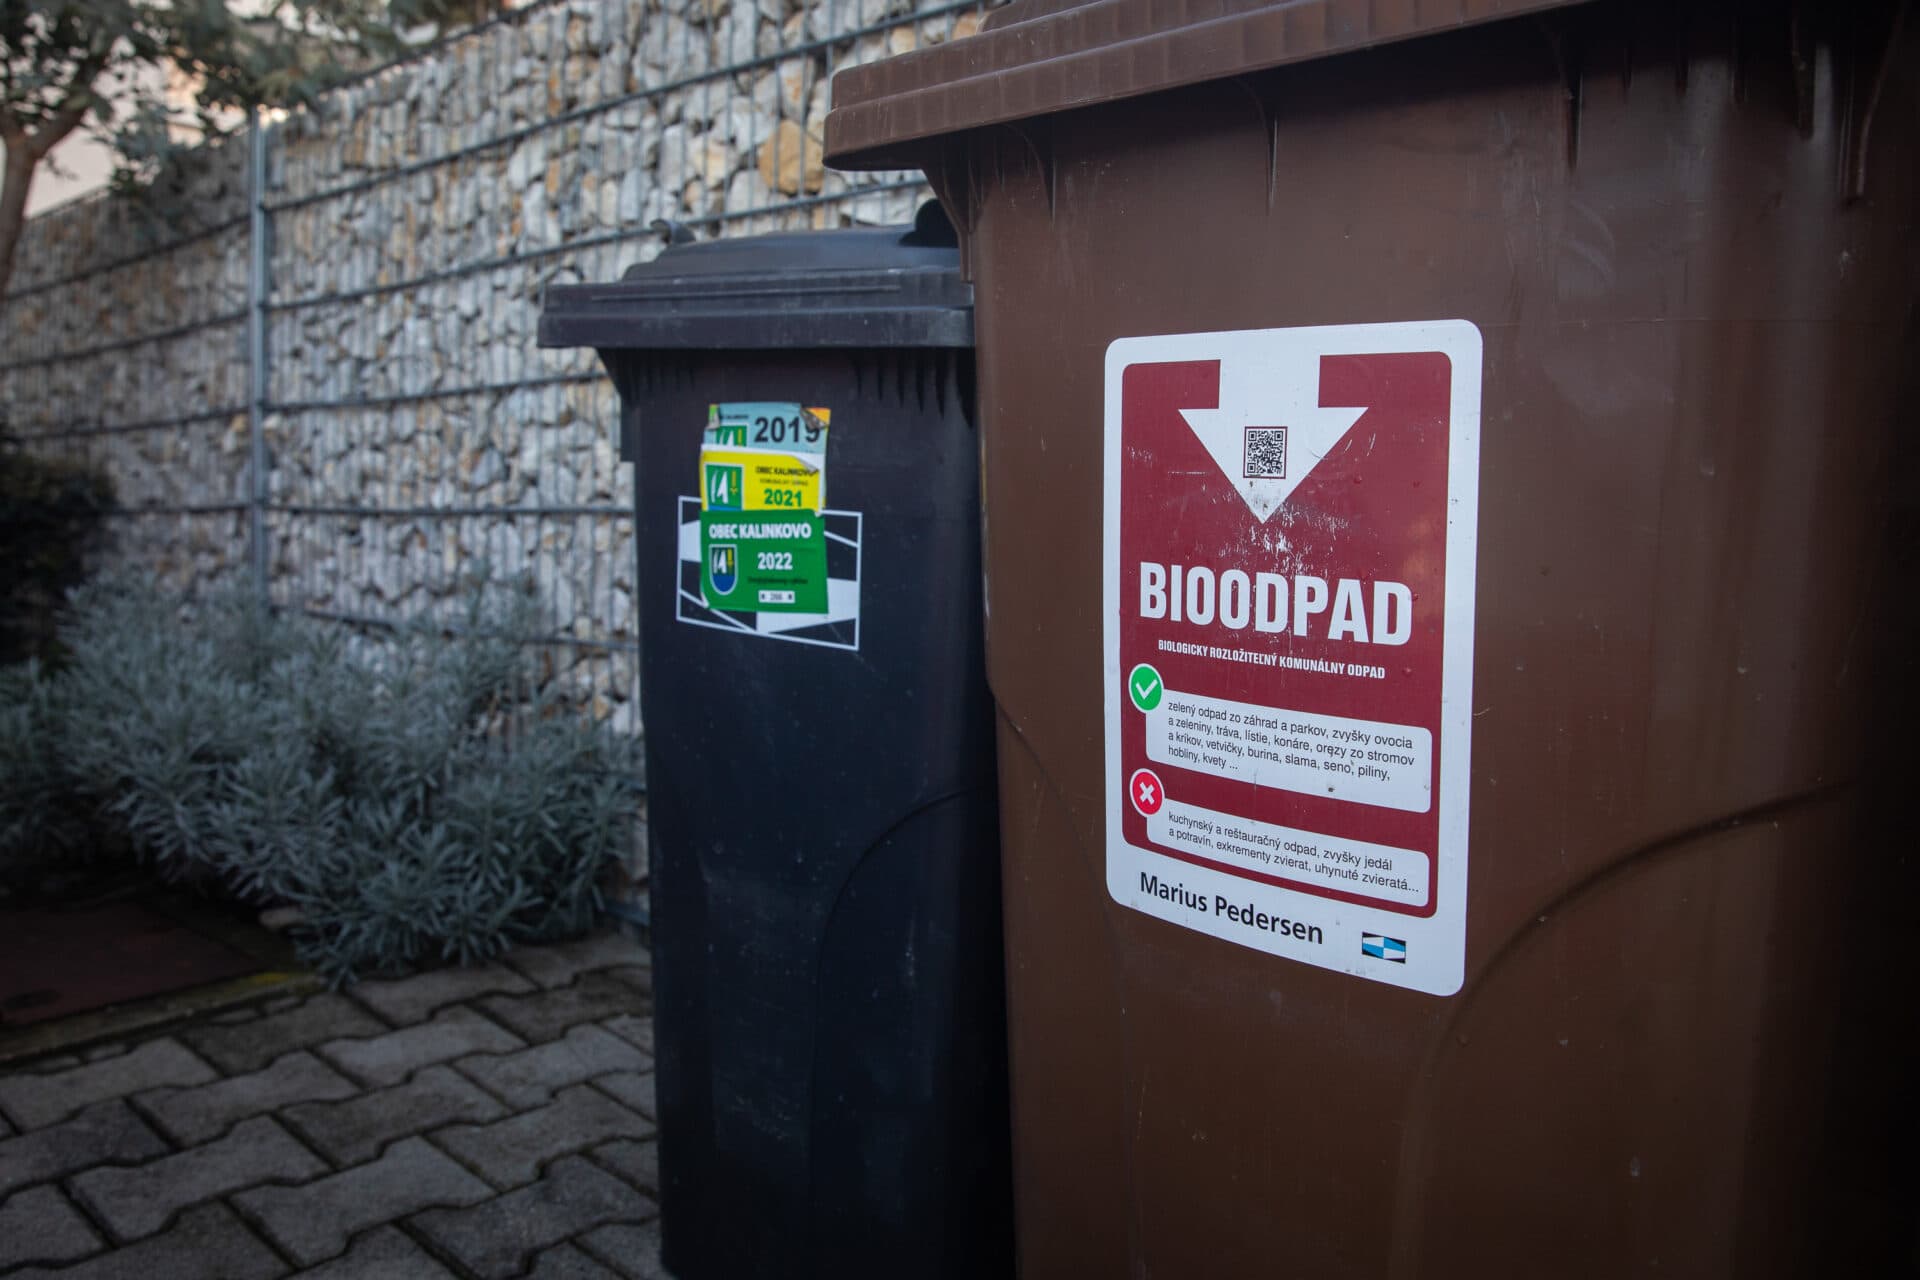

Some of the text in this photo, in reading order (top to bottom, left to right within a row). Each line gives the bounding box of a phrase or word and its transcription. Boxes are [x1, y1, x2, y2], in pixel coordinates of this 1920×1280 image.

[754, 416, 820, 443] 2019
[764, 488, 802, 507] 2021
[709, 522, 812, 539] OBEC KALINKOVO
[757, 552, 793, 570] 2022
[1140, 562, 1413, 646] BIOODPAD
[1158, 639, 1385, 679] BIOLOGICKY ROZLOŽITEĽNÝ KOMUNÁLNY ODPAD
[1168, 702, 1413, 749] zelený odpad zo záhrad a parkov, zvyšky ovocia
[1168, 717, 1415, 766] a zeleniny, tráva, lístie, konáre, orezy zo stromov
[1168, 732, 1390, 781] a kríkov, vetvičky, burina, slama, seno, piliny,
[1168, 746, 1200, 764] hobliny,
[1203, 752, 1227, 769] kvety
[1168, 811, 1392, 871] kuchynský a reštauračný odpad, zvyšky jedál
[1168, 828, 1419, 892] a potravín, exkrementy zvierat, uhynuté zvieratá...
[1140, 871, 1323, 945] Marius Pedersen
